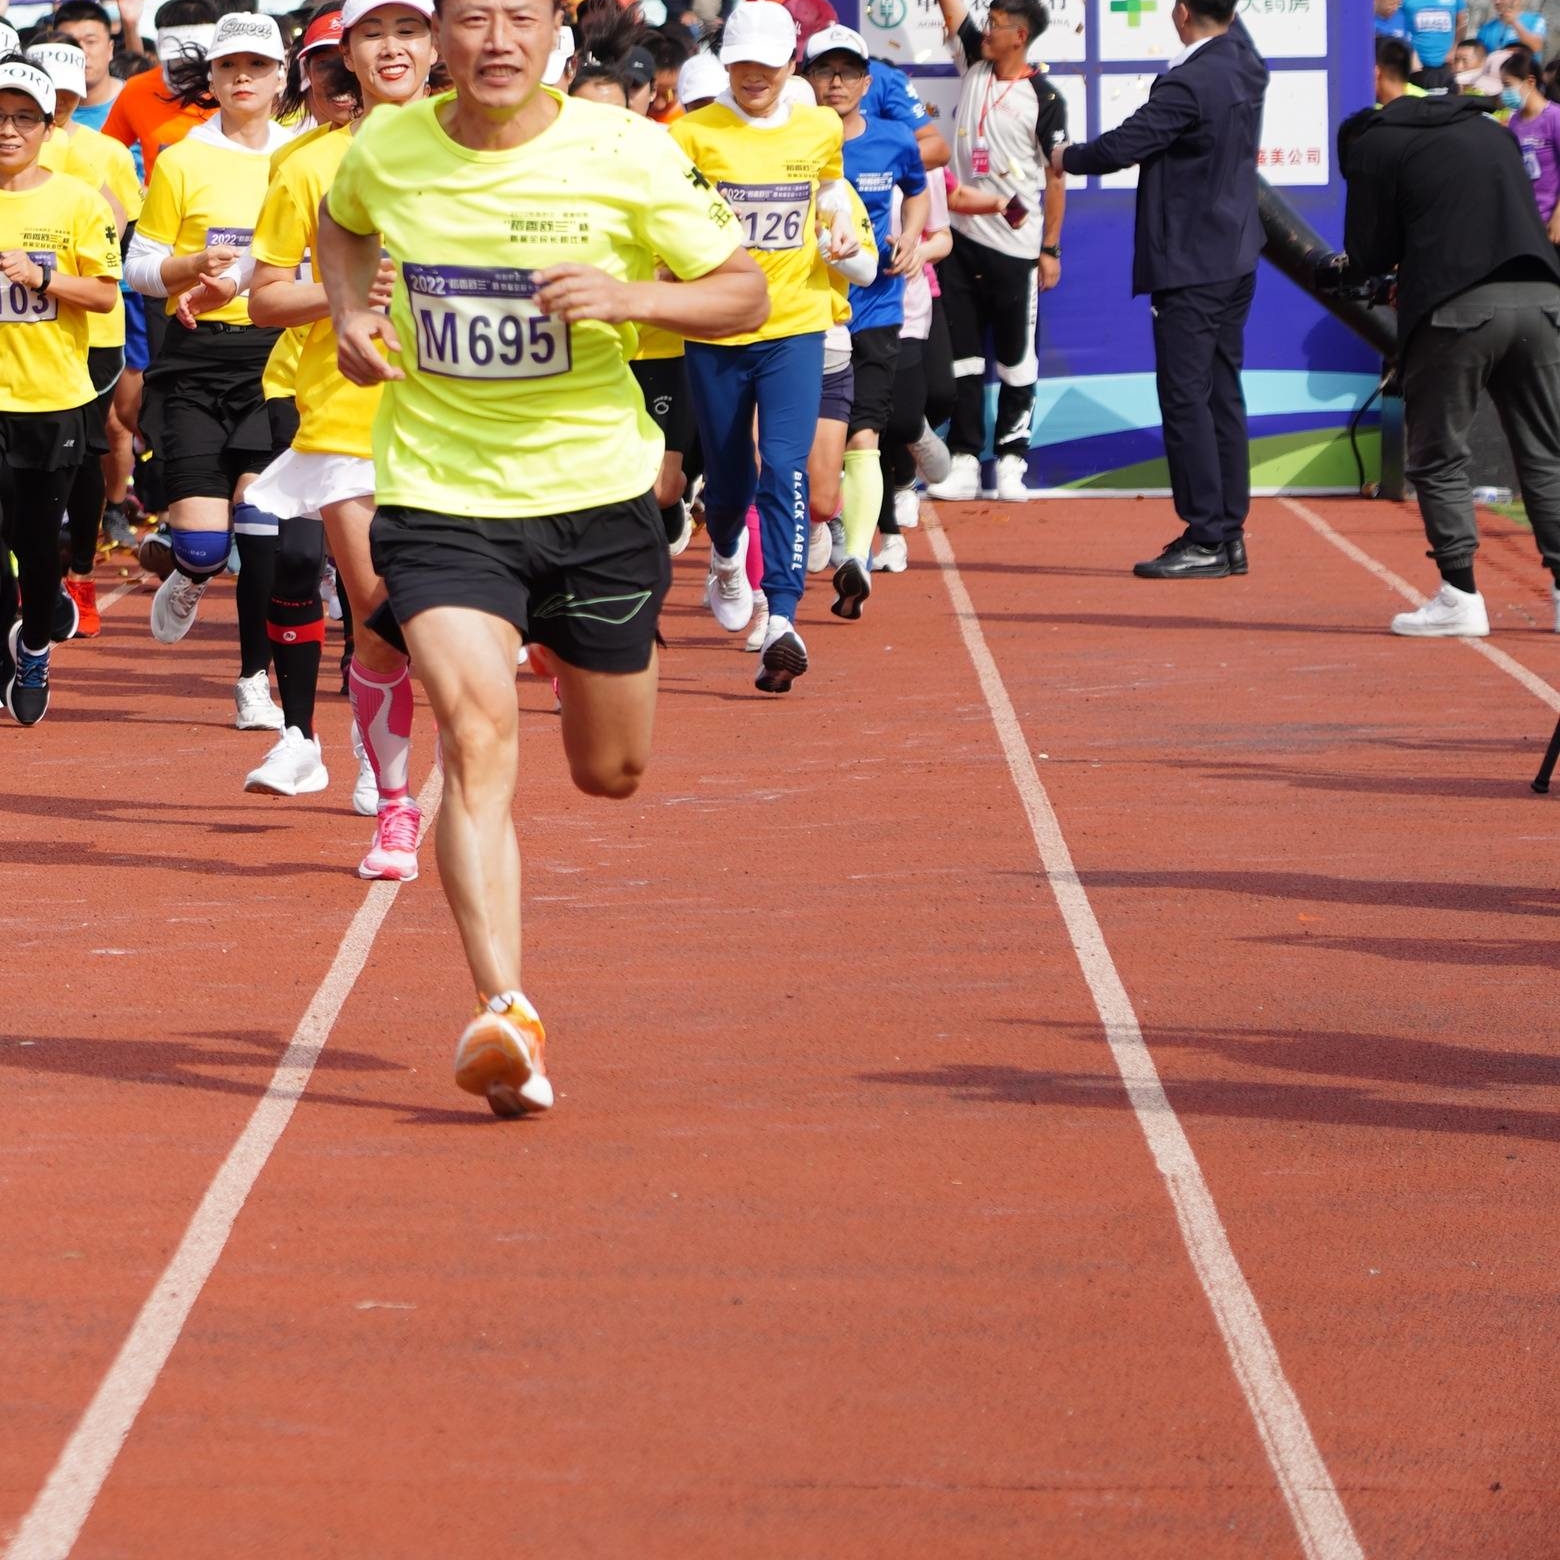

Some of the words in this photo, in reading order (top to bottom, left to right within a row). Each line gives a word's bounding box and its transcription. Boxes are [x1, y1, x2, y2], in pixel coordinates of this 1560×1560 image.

[727, 188, 746, 201] 022
[211, 233, 236, 245] 2022
[744, 210, 802, 241] 126
[409, 273, 446, 295] 2022
[419, 307, 556, 367] M695
[791, 470, 806, 524] BLACK
[791, 525, 805, 572] LABEL
